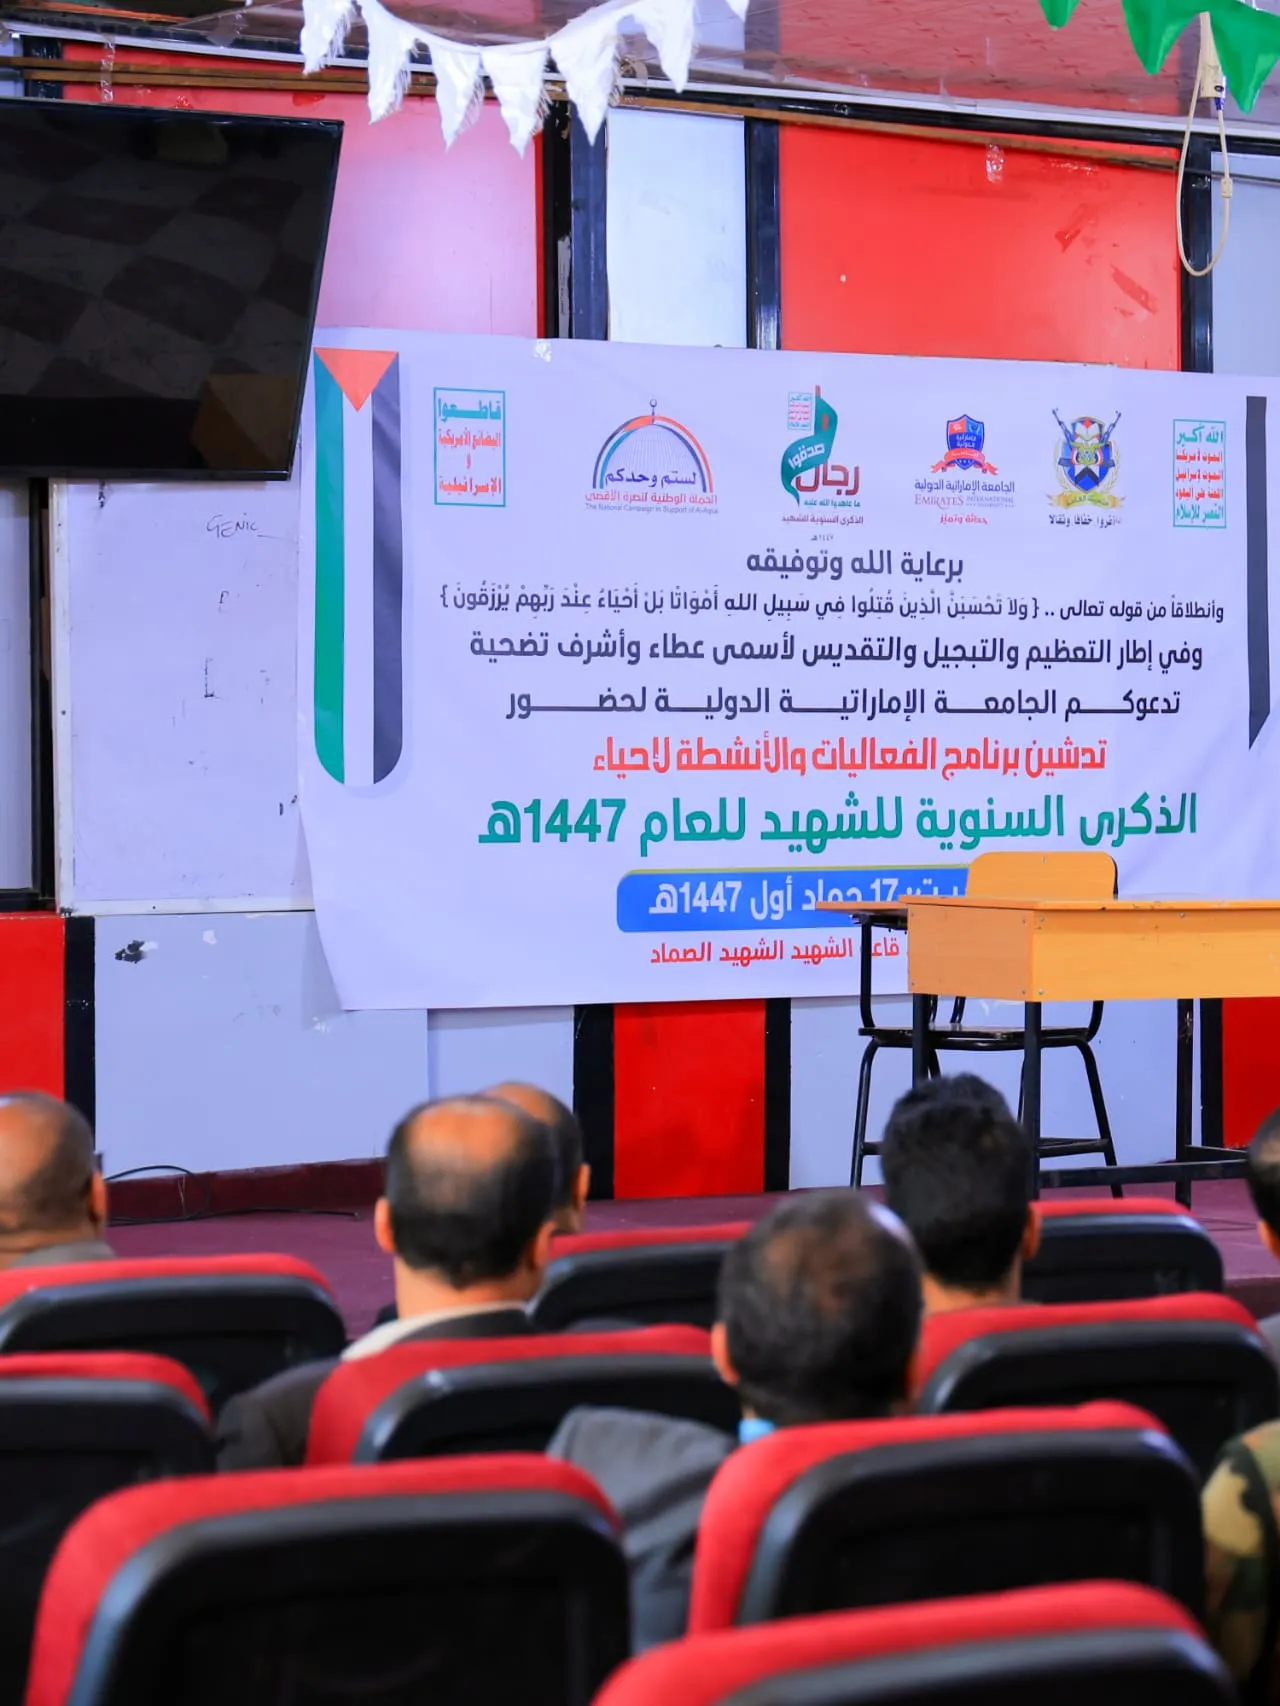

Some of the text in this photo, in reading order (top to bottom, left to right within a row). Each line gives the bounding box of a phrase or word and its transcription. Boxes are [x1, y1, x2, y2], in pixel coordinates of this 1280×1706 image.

[438, 398, 501, 423] قاطعوا
[1176, 422, 1224, 447] الله أكبر
[605, 468, 697, 489] لستم وحدكم
[795, 461, 860, 496] رجال
[981, 480, 1015, 494] الجامعة
[747, 548, 964, 584] برعاية الله وتوفيقه
[1060, 599, 1104, 620] تعالى
[1110, 600, 1143, 622] قوله
[1147, 602, 1167, 621] من
[470, 628, 1203, 675] وفي إطار التعظيم والتبجيل والتقديس لأسمى عطاء وأشرف تضحية
[506, 686, 1181, 723] تدعوكم الجامعة الإماراتية الدولية لحضور
[676, 731, 806, 777] والأنشطة
[812, 736, 937, 779] الفعاليات
[942, 736, 1020, 781] برنامج
[1025, 736, 1107, 779] تدشين
[478, 790, 1197, 858] الذكرى السنوية للشهيد للعام 1447هـ
[648, 880, 743, 915] 1447هـ
[750, 875, 793, 920] أول
[650, 936, 900, 968] قاع الشهيد الشهيد الصماد
